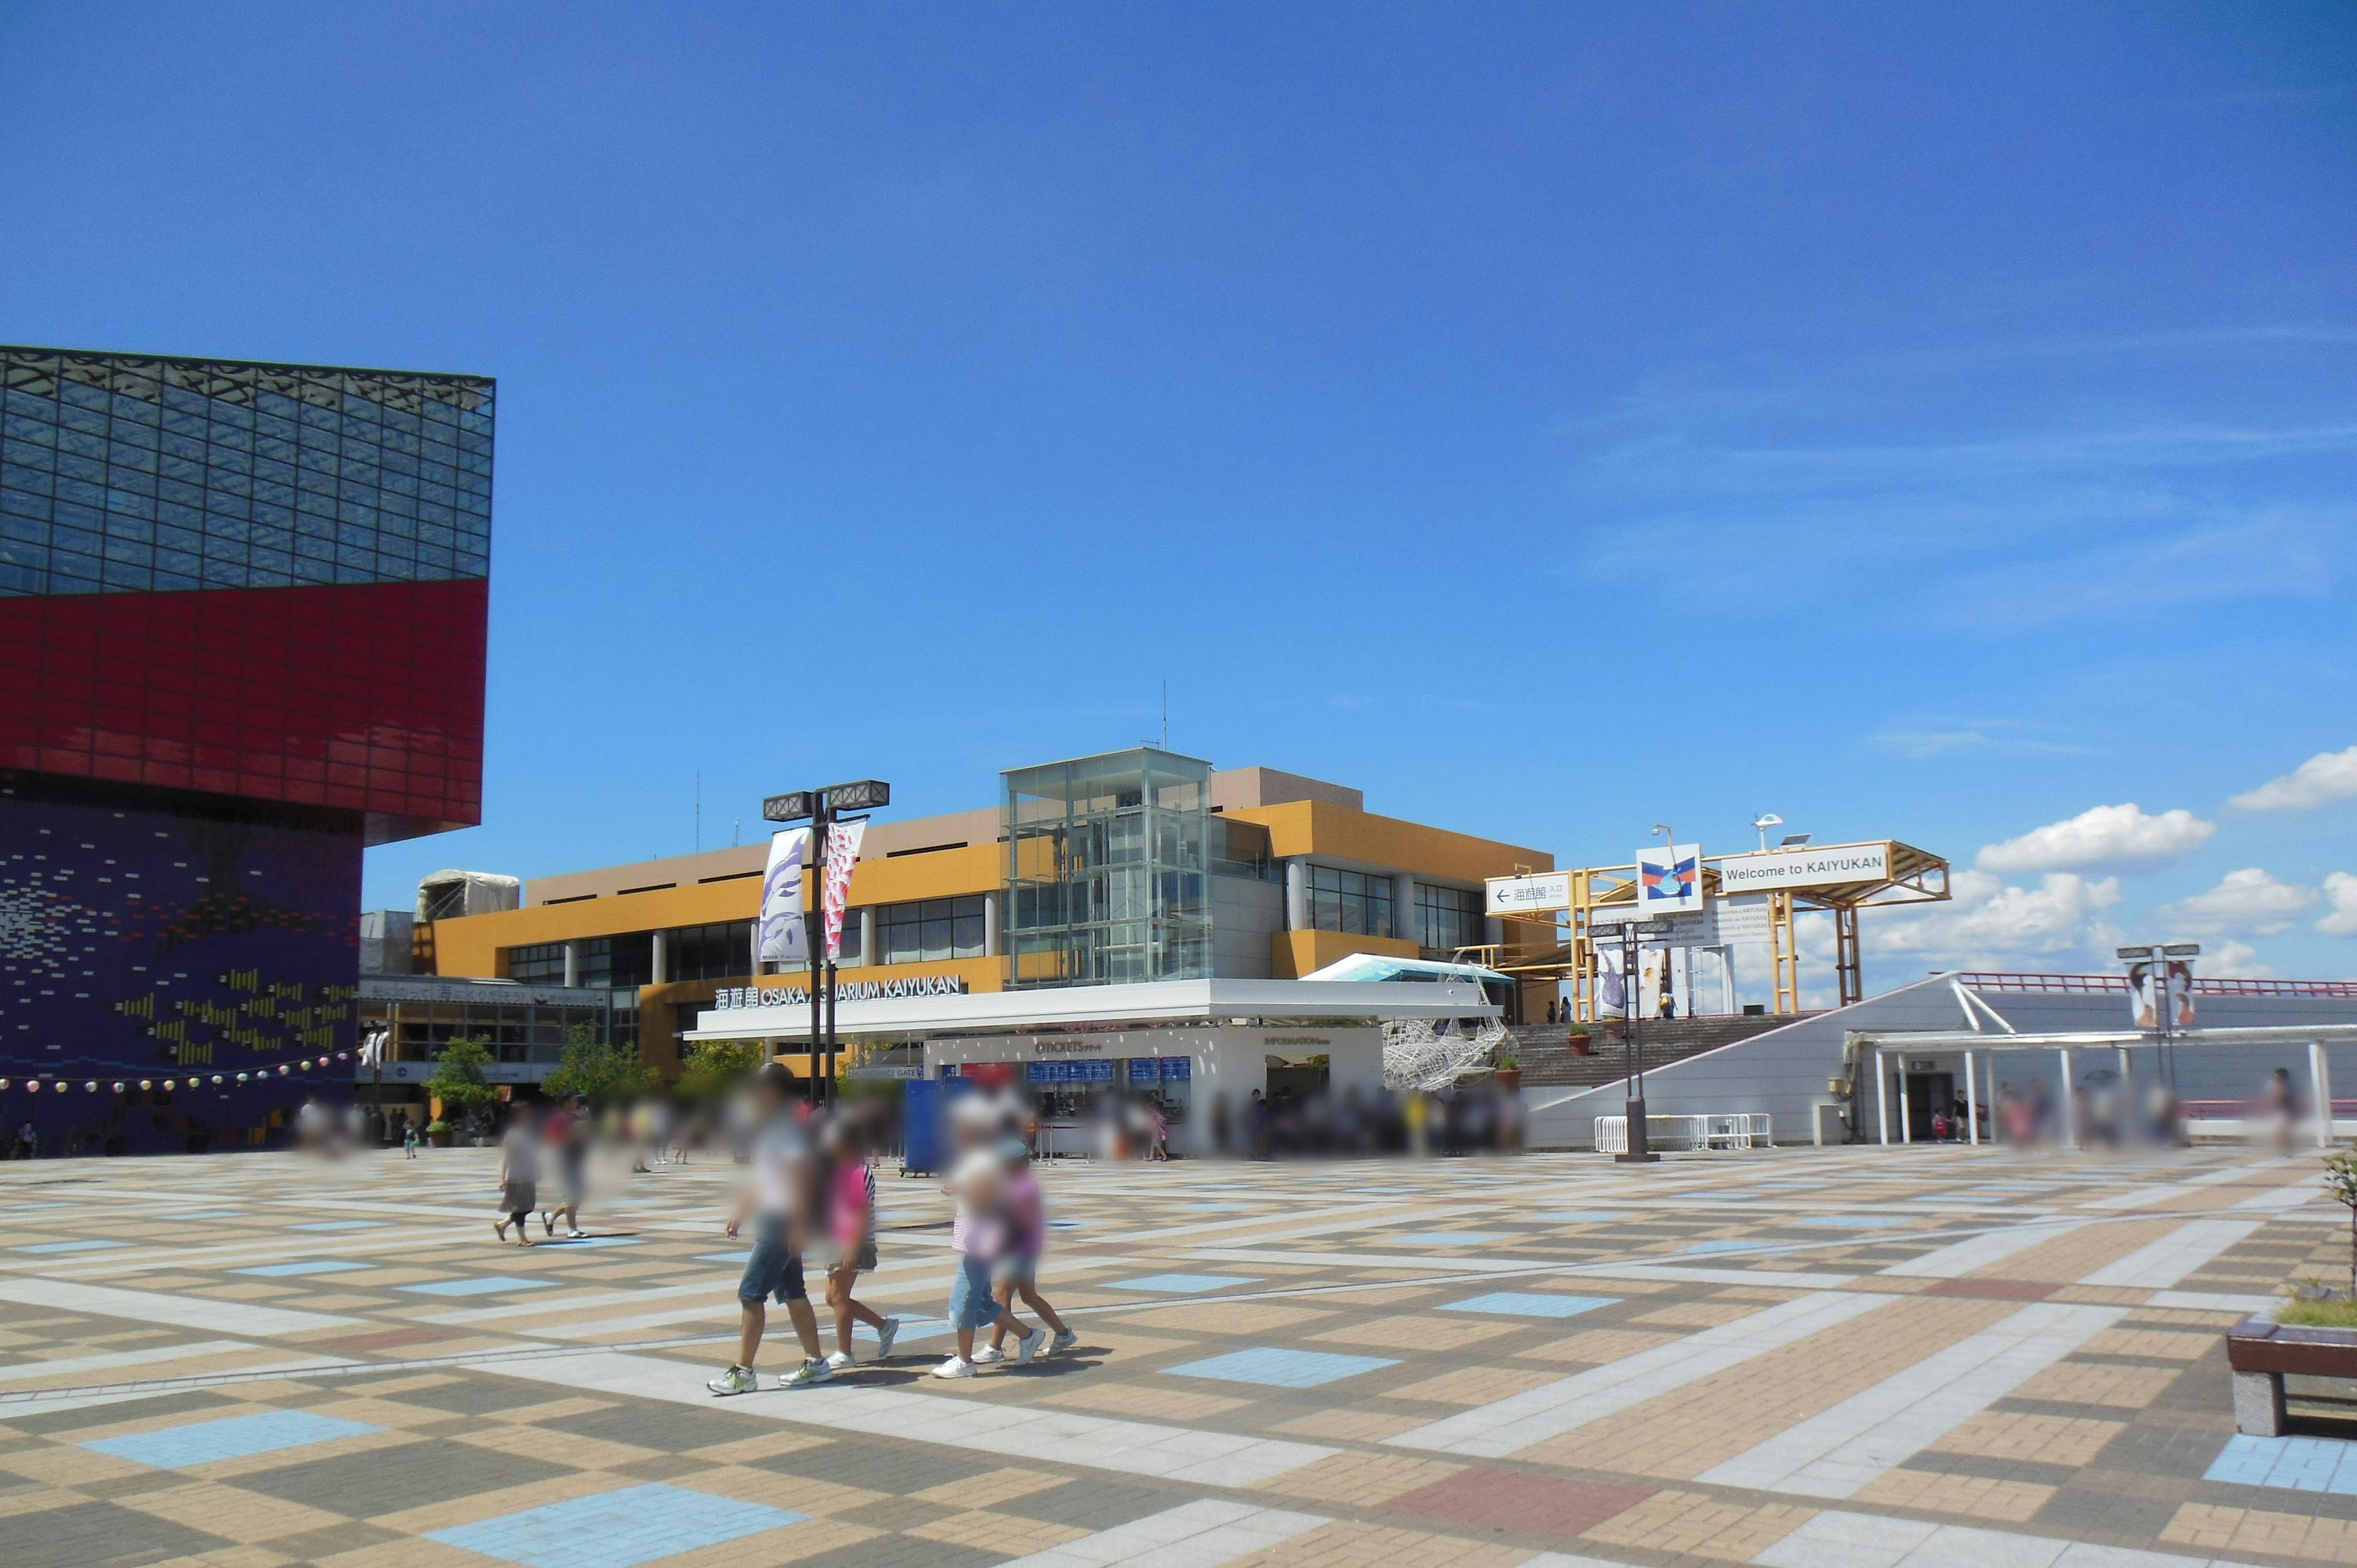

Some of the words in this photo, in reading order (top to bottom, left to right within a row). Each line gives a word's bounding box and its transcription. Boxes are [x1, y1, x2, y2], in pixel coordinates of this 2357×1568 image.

[1726, 866, 1786, 881] Welcome
[1789, 864, 1803, 875] to
[1806, 856, 1883, 873] KAIYUKAN
[1514, 886, 1546, 902] 海遊館
[714, 986, 759, 1010] 海遊館
[761, 986, 807, 1006] OSAKA
[808, 981, 881, 1003] QARIUM
[884, 974, 961, 998] KAIYUKAN
[1045, 1041, 1083, 1053] TICKETS
